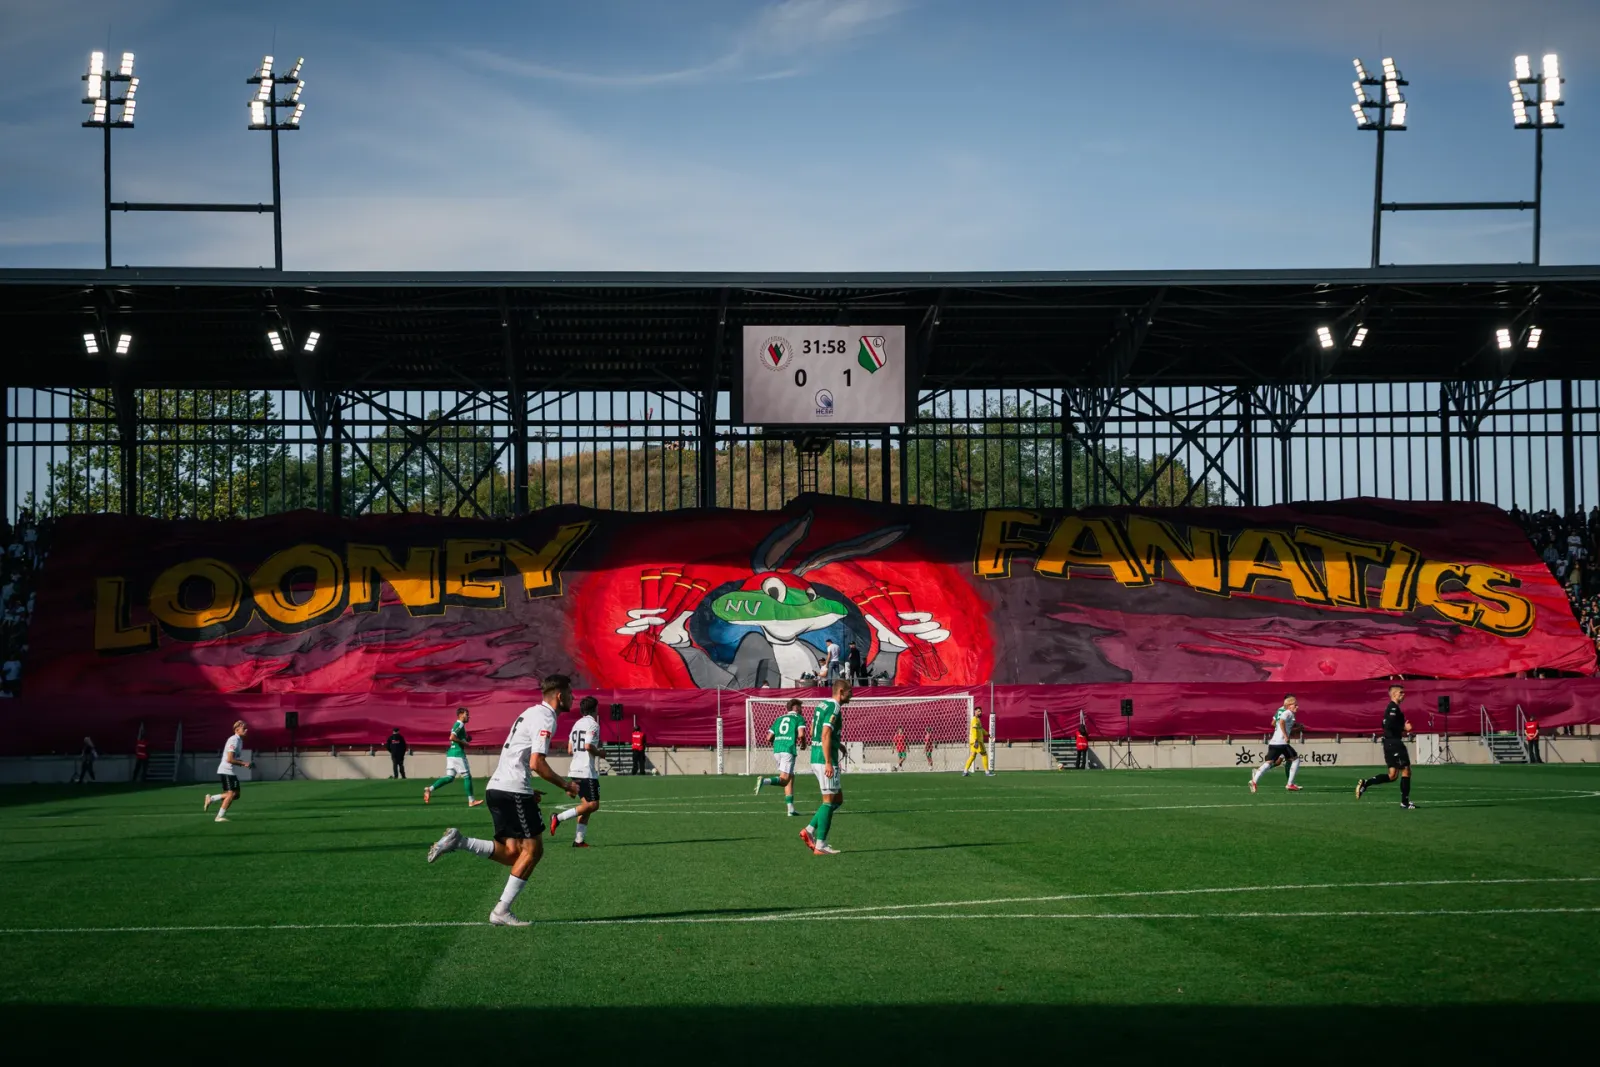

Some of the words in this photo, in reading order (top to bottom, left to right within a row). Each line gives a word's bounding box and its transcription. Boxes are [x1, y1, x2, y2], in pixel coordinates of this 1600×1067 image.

[802, 339, 846, 354] 31:58
[795, 368, 807, 387] 0
[842, 368, 852, 387] 1
[93, 520, 597, 655] LOONEY
[973, 510, 1536, 638] FANATICS
[779, 717, 791, 735] 6
[571, 730, 587, 752] 96
[1312, 750, 1338, 765] łączy
